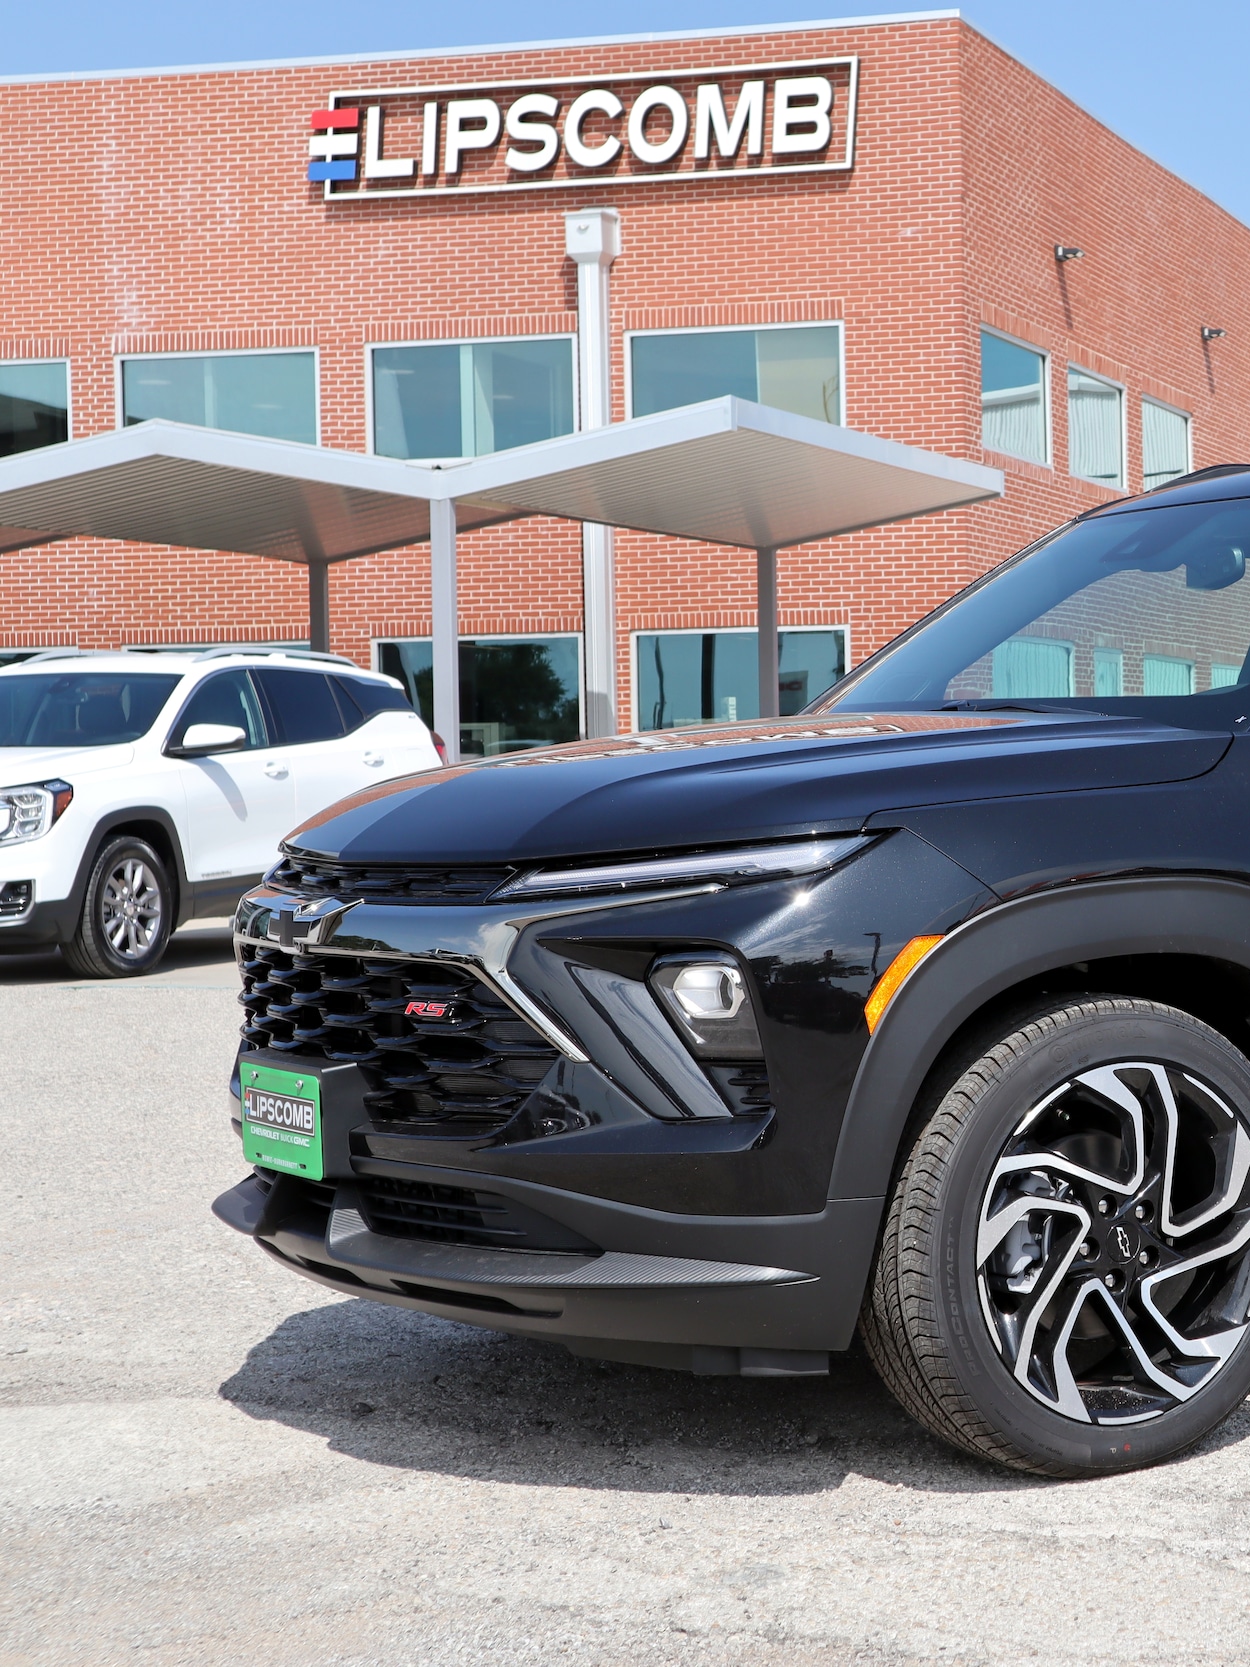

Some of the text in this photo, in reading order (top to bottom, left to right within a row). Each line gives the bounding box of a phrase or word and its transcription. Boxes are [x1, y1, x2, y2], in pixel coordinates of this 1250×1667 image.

[363, 76, 833, 178] LIPSCOMB
[404, 1001, 448, 1017] RS
[249, 1093, 313, 1130] LIPSCOMB
[293, 1136, 310, 1148] GMC
